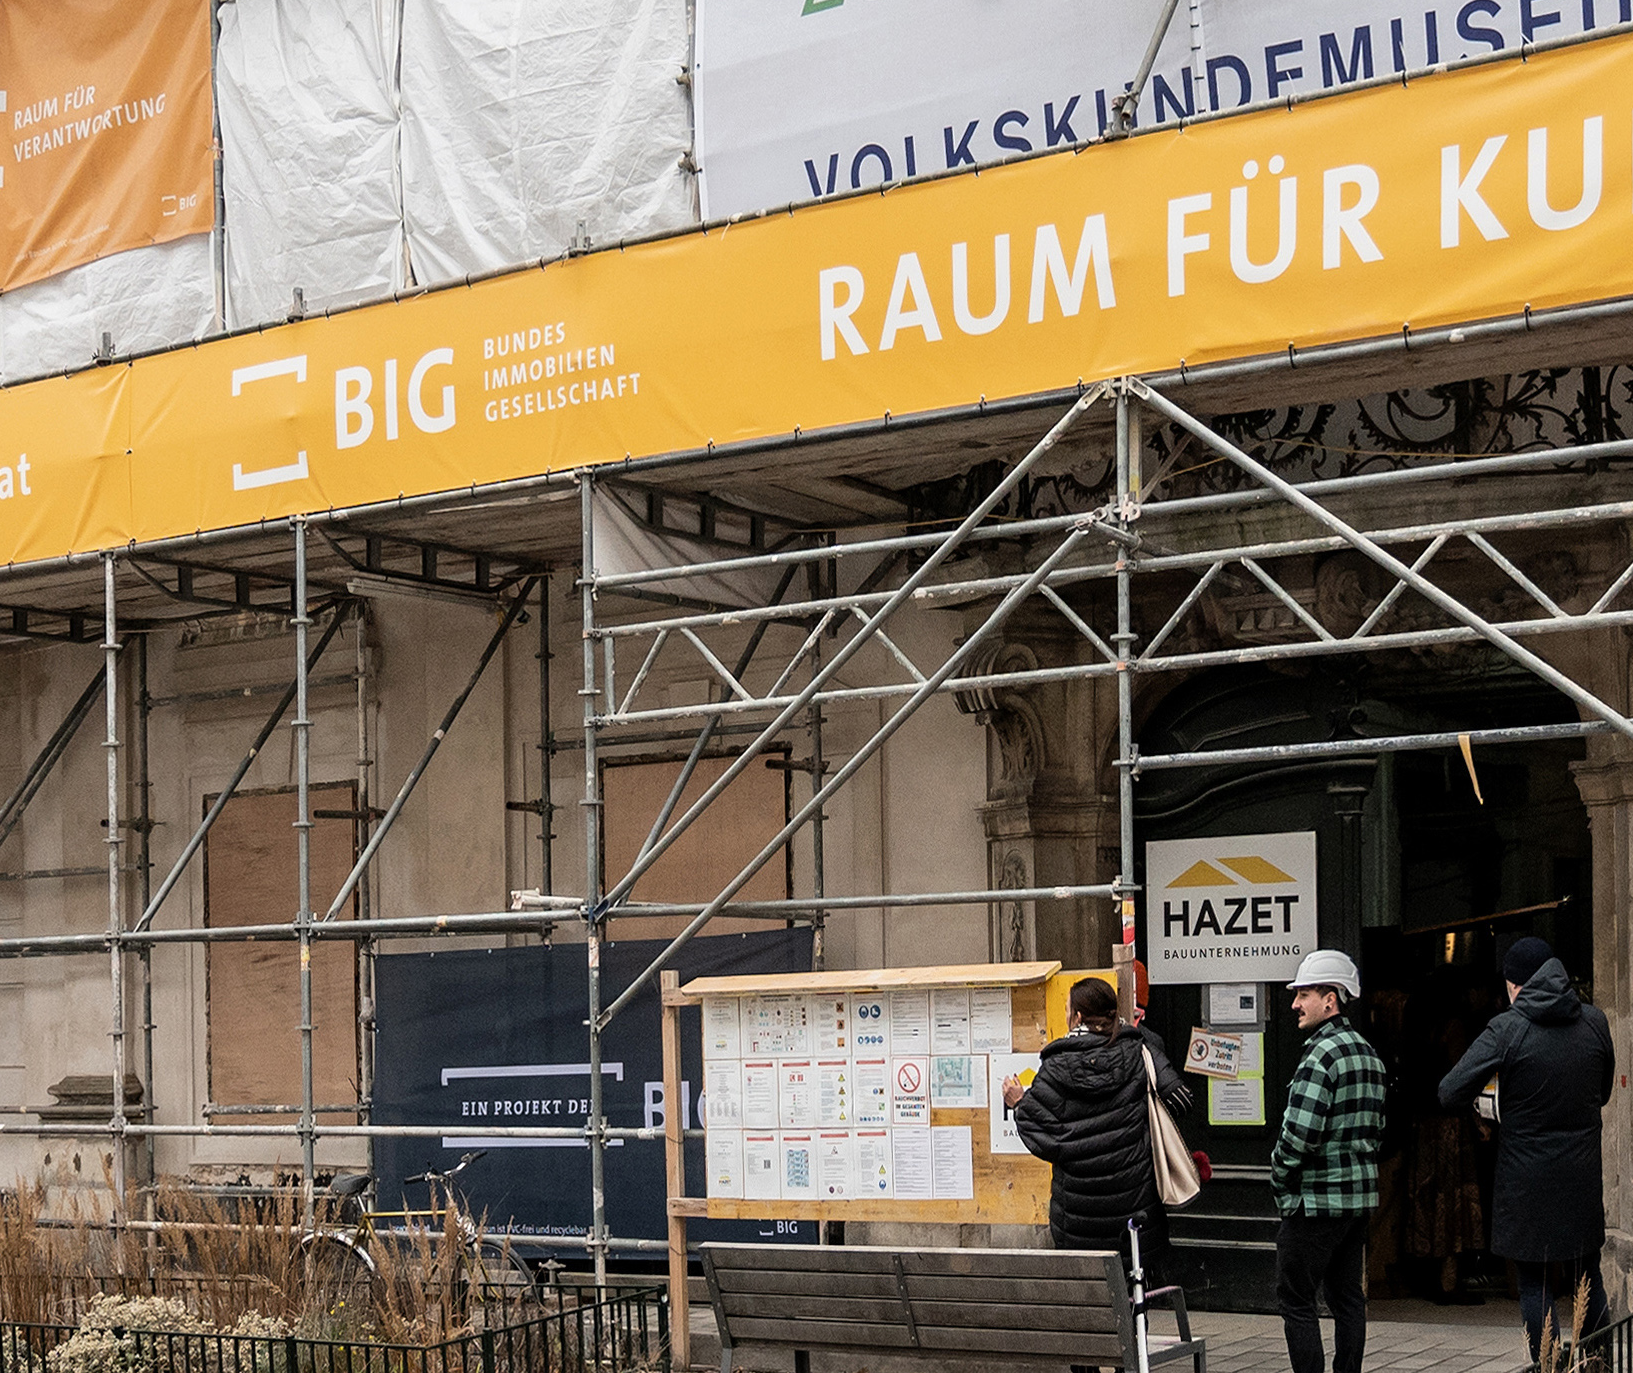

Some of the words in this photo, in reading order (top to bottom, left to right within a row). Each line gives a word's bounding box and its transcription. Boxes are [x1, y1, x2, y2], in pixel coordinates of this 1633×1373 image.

[14, 97, 58, 131] RAUM
[64, 84, 96, 115] FÜR
[14, 93, 166, 164] VERANTWORTUNG
[179, 193, 196, 211] BIG
[817, 211, 1117, 361] RAUM
[1166, 153, 1384, 298] FÜR
[483, 319, 567, 361] BUNDES
[483, 343, 616, 392] IMMOBILIEN
[334, 347, 456, 451] BIG
[484, 372, 642, 423] GESELLSCHAFT
[1164, 896, 1299, 937] HAZET
[1164, 945, 1301, 960] BAUUNTERNEHMUNG
[462, 1102, 489, 1116] EIN
[494, 1101, 562, 1115] PROJEKT
[568, 1100, 593, 1114] DE
[644, 1081, 706, 1129] BI
[536, 1225, 549, 1234] und
[777, 1220, 798, 1234] BIG
